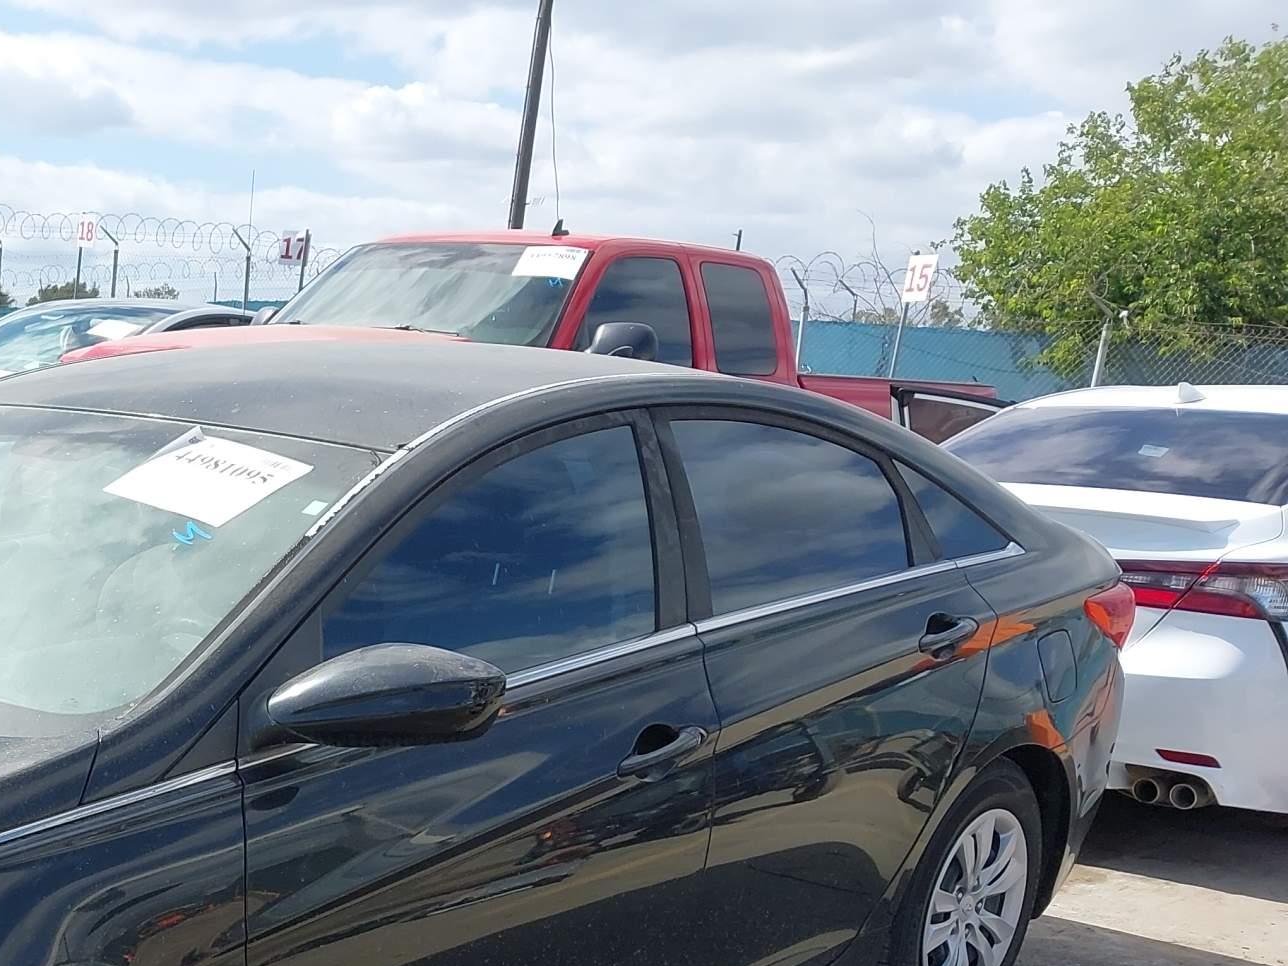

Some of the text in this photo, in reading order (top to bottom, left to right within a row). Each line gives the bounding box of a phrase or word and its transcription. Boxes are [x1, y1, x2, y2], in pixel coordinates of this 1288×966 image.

[78, 220, 95, 242] 18
[281, 237, 304, 260] 17
[905, 264, 933, 292] 15
